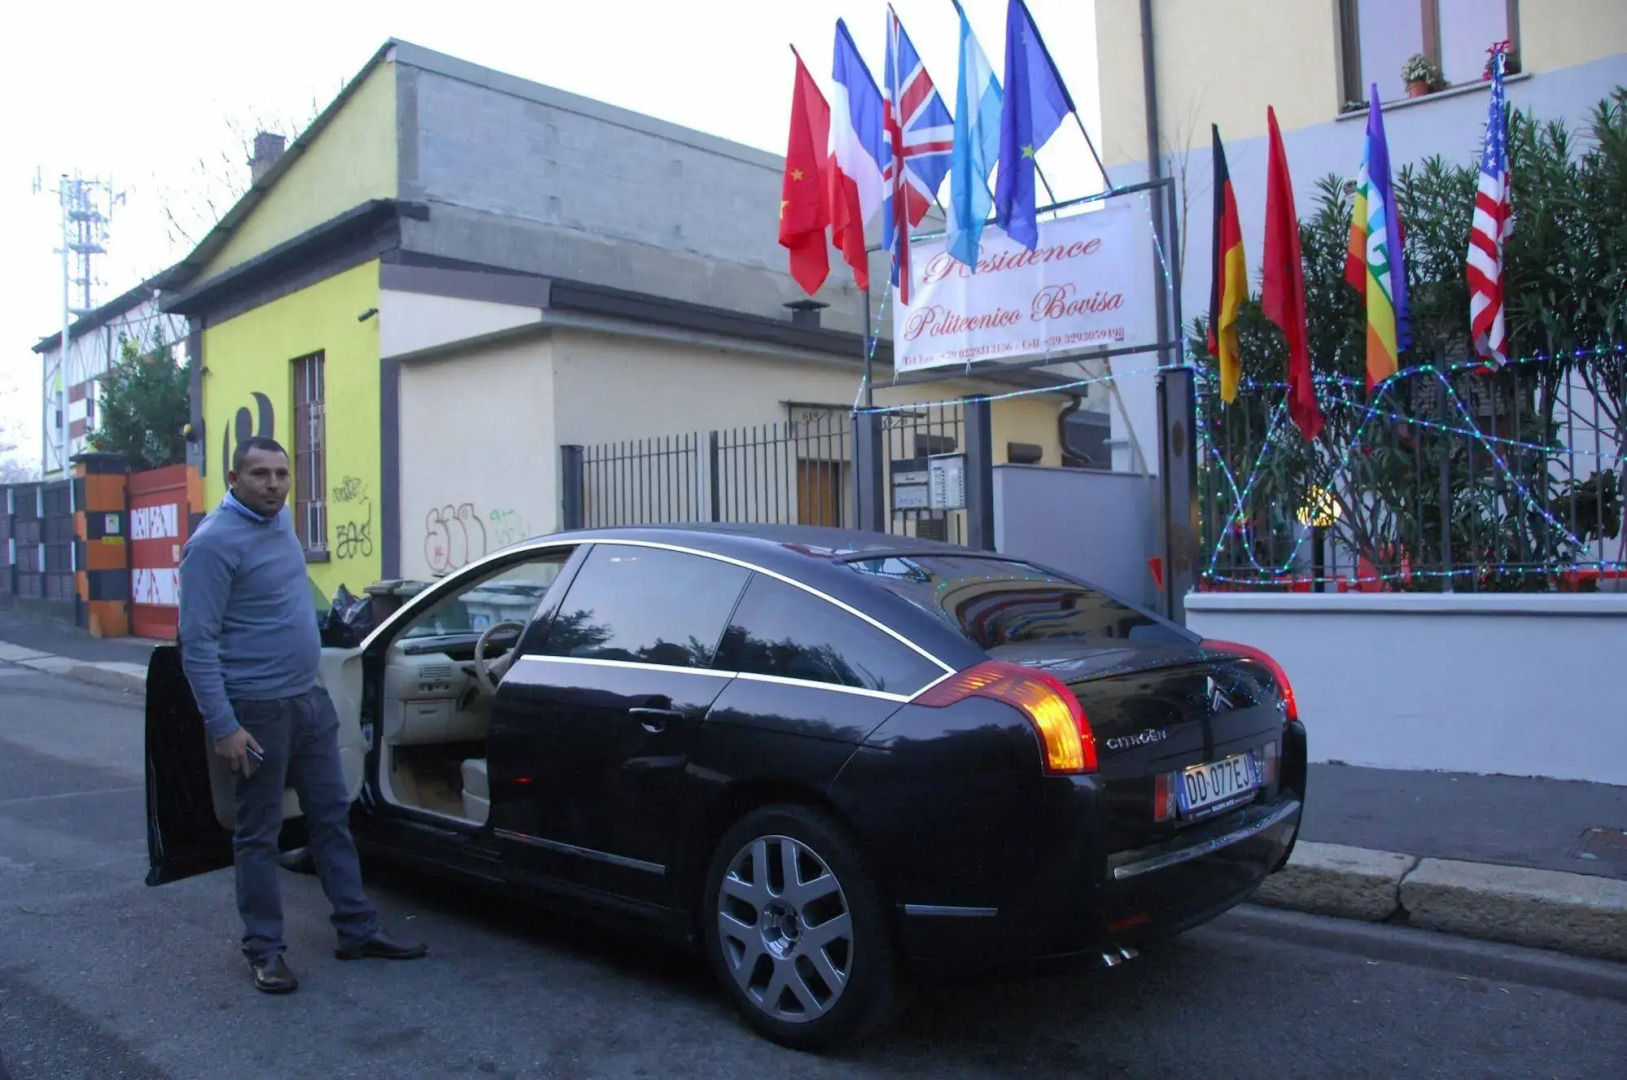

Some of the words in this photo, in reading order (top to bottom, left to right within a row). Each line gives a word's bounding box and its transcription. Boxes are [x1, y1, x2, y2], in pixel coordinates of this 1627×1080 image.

[923, 237, 1102, 284] Residence
[904, 306, 1022, 341] Politecnico
[1031, 283, 1125, 321] Bovisa
[1186, 771, 1208, 804] DD
